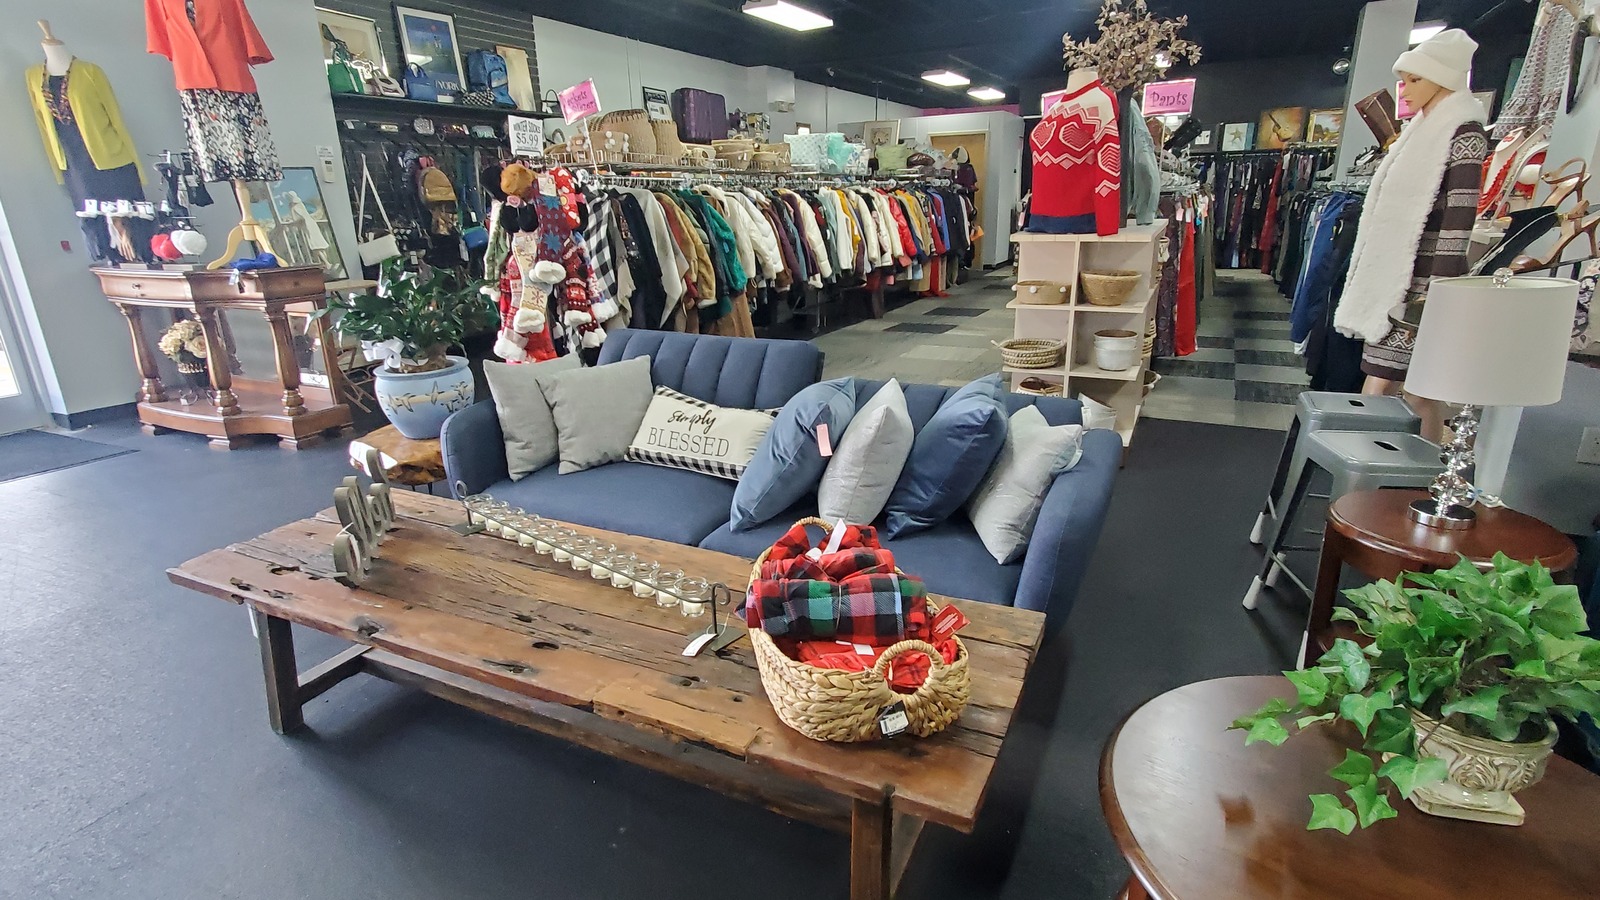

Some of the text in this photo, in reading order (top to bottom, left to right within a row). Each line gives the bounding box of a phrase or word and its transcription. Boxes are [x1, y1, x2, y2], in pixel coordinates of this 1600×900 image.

[1150, 91, 1188, 108] Pants
[516, 132, 539, 147] $5.99
[667, 409, 717, 434] simply
[647, 427, 730, 457] BLESSED
